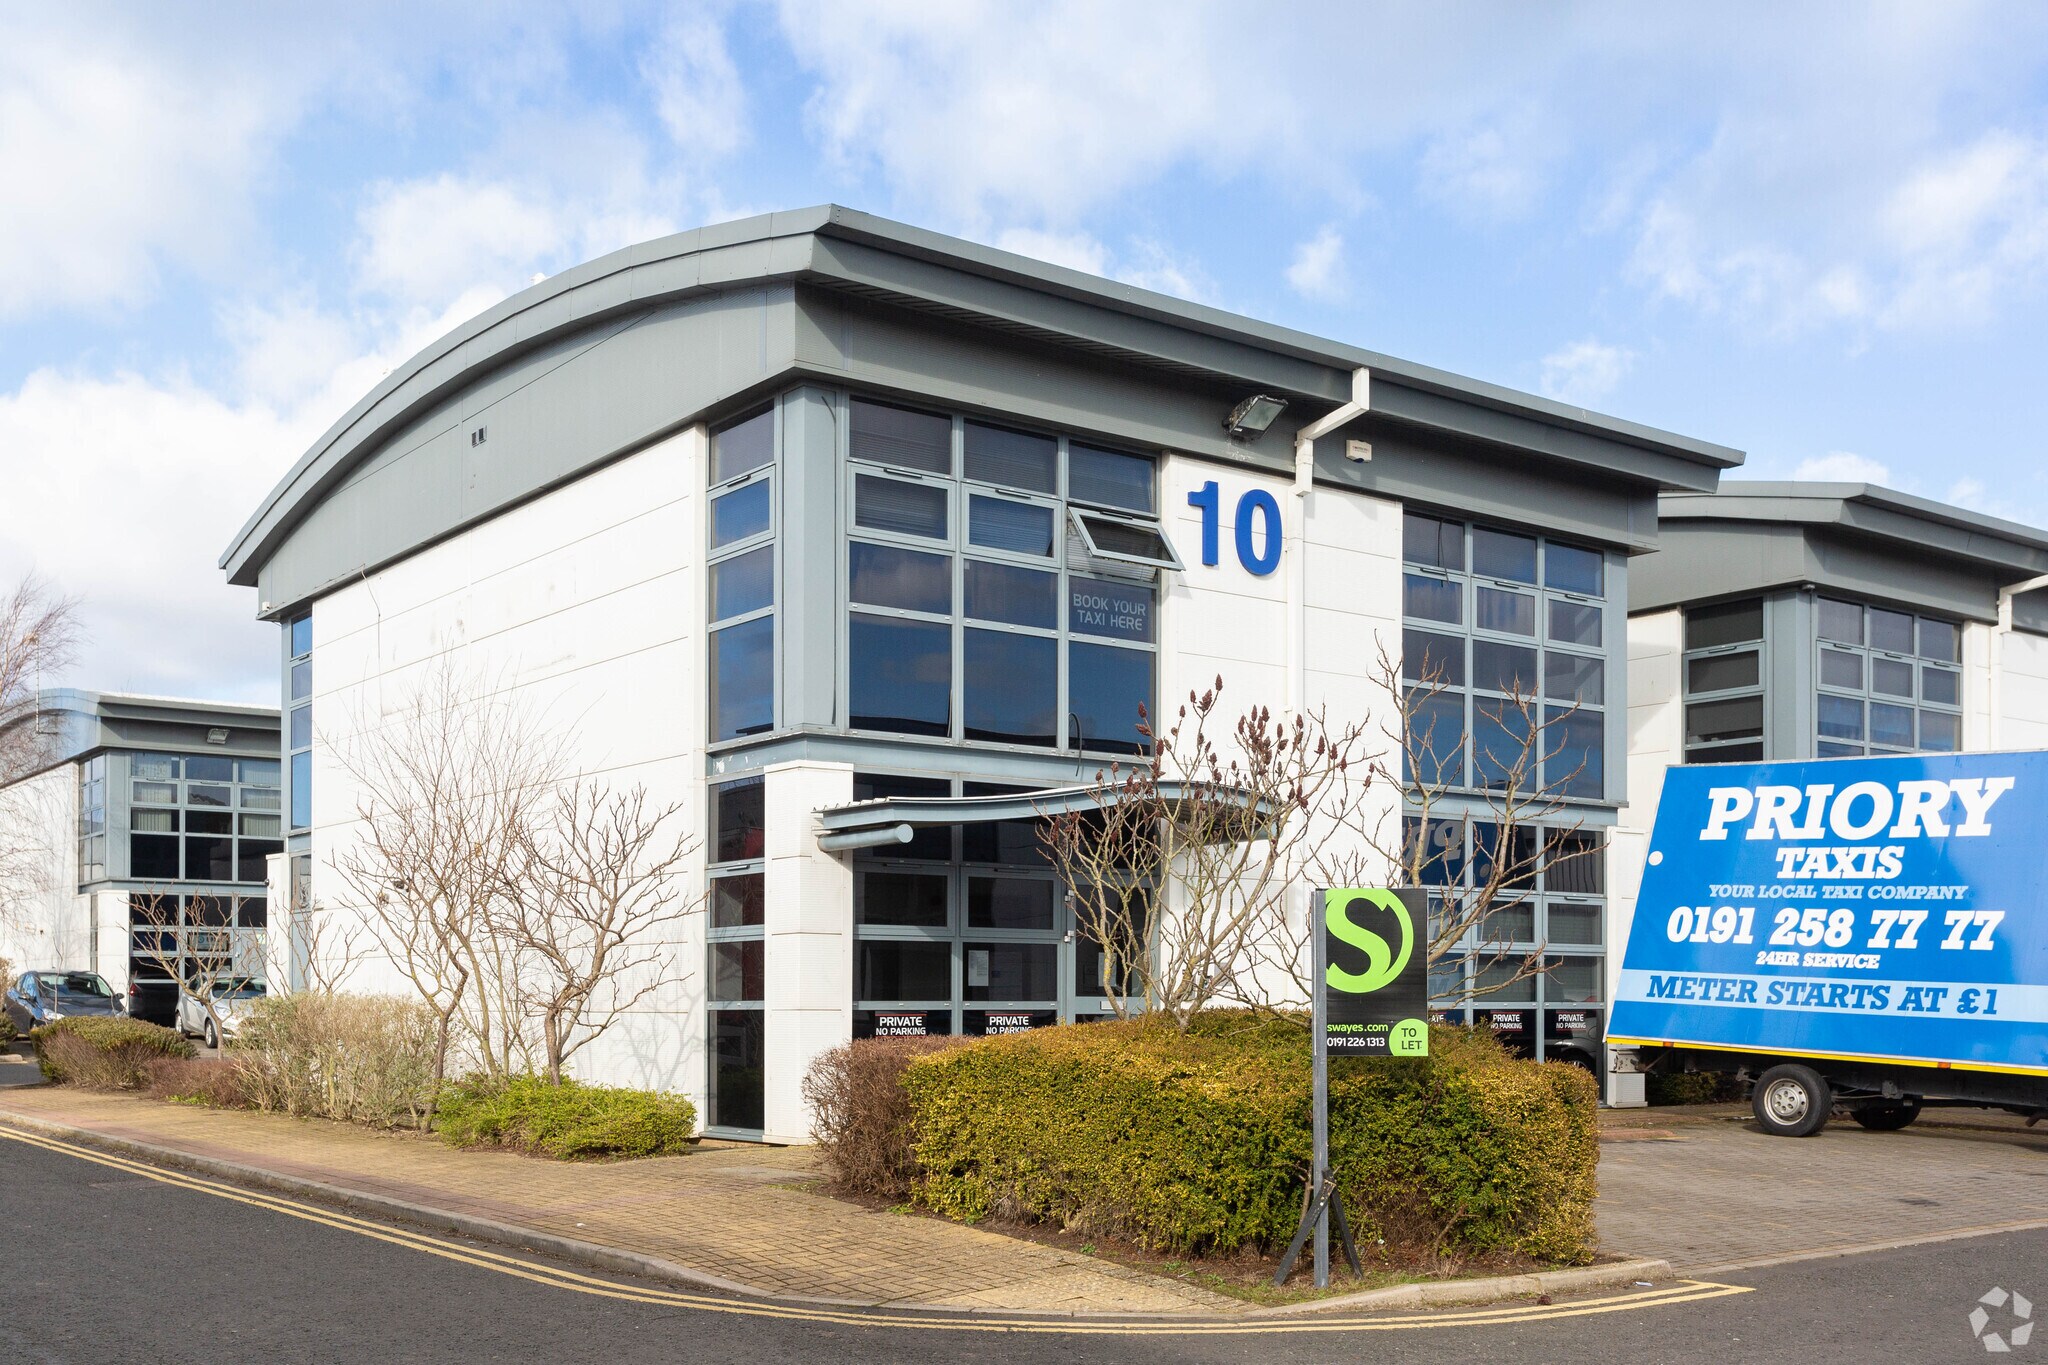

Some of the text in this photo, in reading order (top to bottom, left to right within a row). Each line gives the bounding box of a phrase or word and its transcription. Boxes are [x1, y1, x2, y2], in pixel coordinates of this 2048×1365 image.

[1187, 480, 1283, 576] 10
[1073, 593, 1146, 616] BOOK YOUR
[1077, 609, 1143, 631] TAXI HERE
[1699, 776, 2016, 841] PRIORY
[1776, 845, 1905, 880] TAXIS
[1708, 884, 1968, 900] YOUR LOCAL TAXI COMPANY
[1667, 906, 2005, 951] 0191 258 77 77
[1755, 952, 1880, 970] 24HR SERVICE
[1646, 975, 1998, 1016] METER STARTS AT £1
[879, 1016, 923, 1027] PRIVATE
[989, 1016, 1029, 1026] PRIVATE
[1492, 1014, 1520, 1022] PRIVATE
[1558, 1014, 1584, 1022] PRIVATE
[875, 1027, 926, 1036] NO PARKING
[986, 1026, 998, 1035] NO
[1401, 1028, 1417, 1038] TO
[1327, 1037, 1385, 1047] 0191 226 1313
[1401, 1040, 1422, 1050] LET
